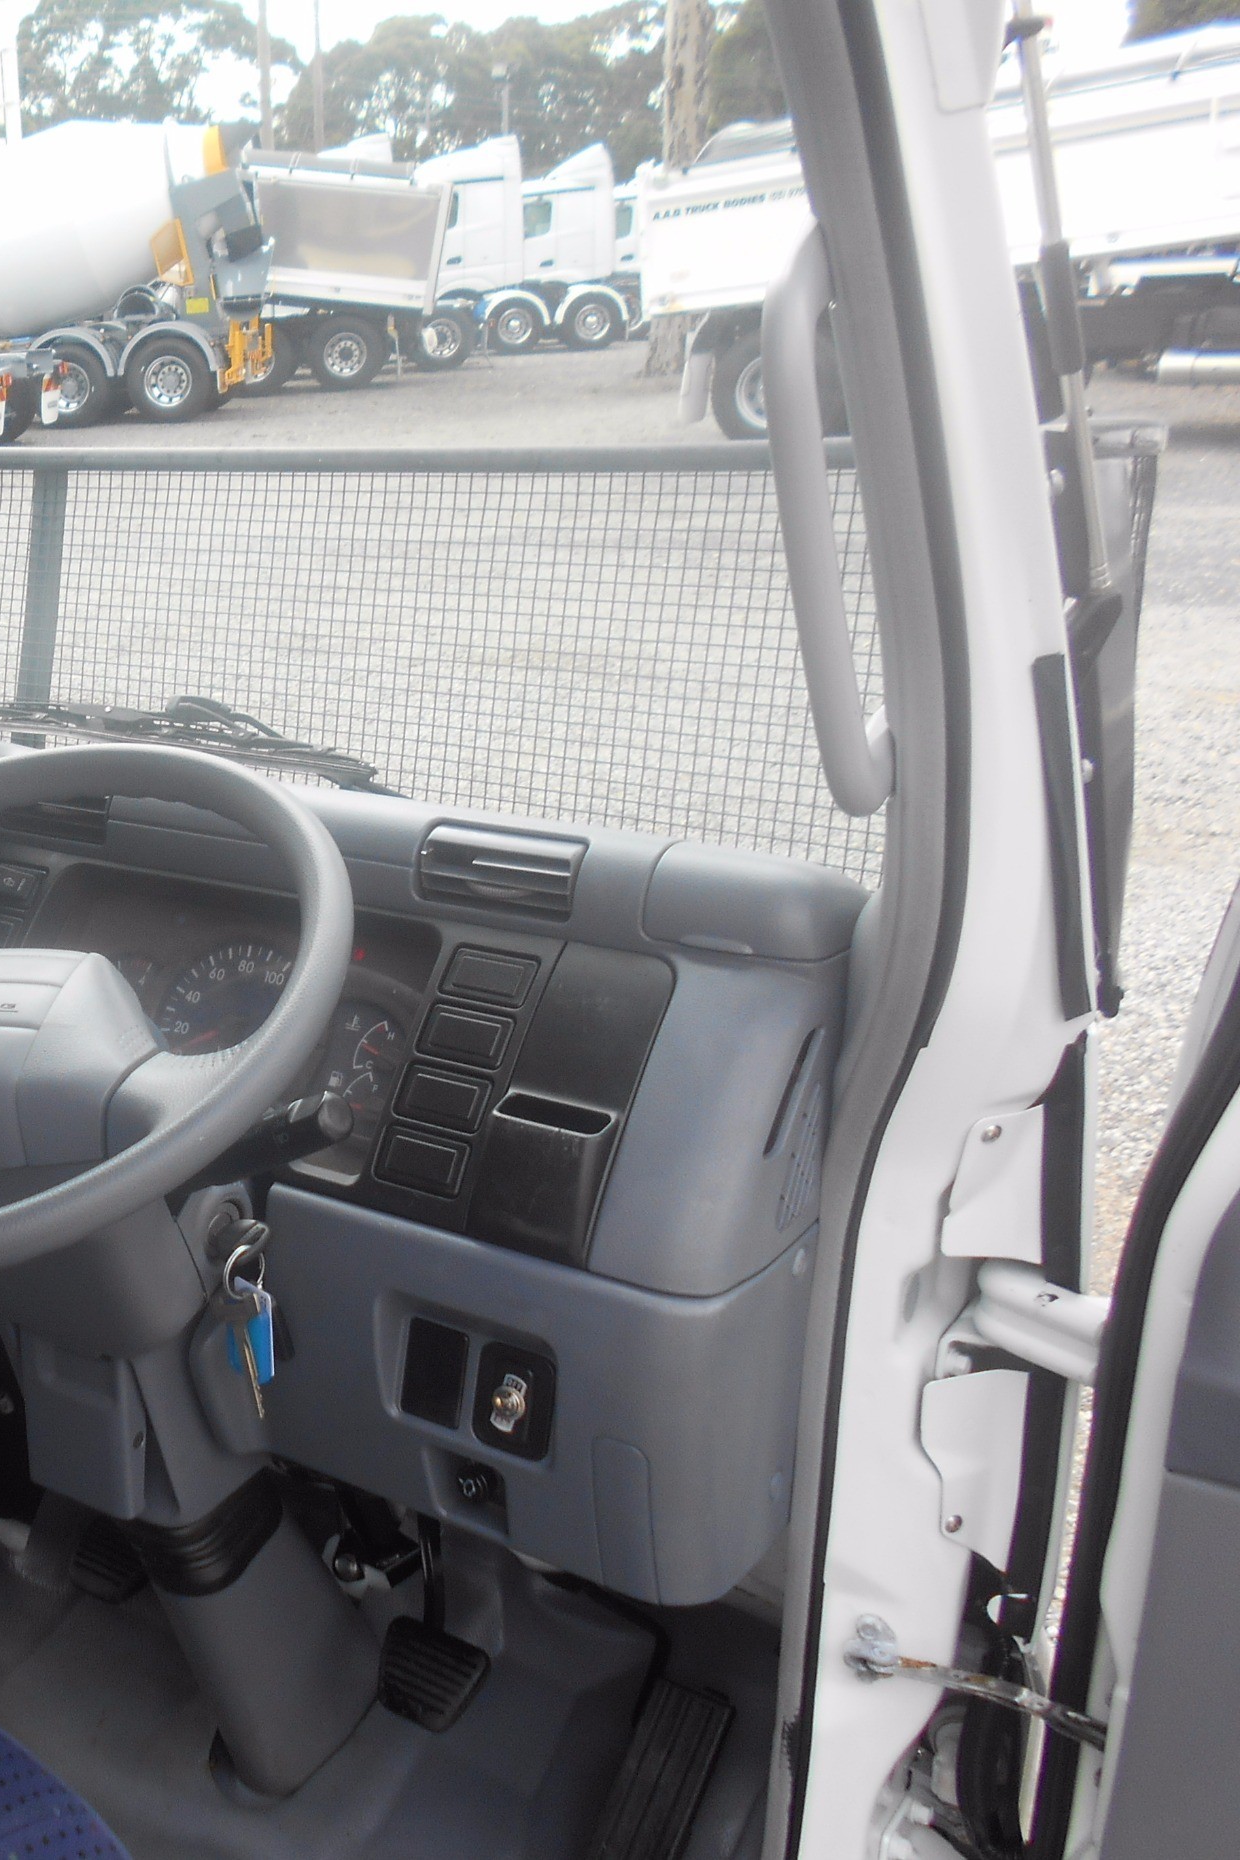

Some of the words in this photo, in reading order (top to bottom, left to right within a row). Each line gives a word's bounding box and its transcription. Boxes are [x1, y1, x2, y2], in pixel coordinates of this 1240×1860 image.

[685, 202, 720, 216] TRUCK
[723, 193, 767, 209] BODIES
[209, 967, 226, 981] 60
[238, 960, 254, 974] 80
[264, 970, 285, 986] 100
[184, 990, 201, 1004] 40
[174, 1020, 189, 1034] 20
[386, 1031, 396, 1041] H
[365, 1060, 374, 1069] C
